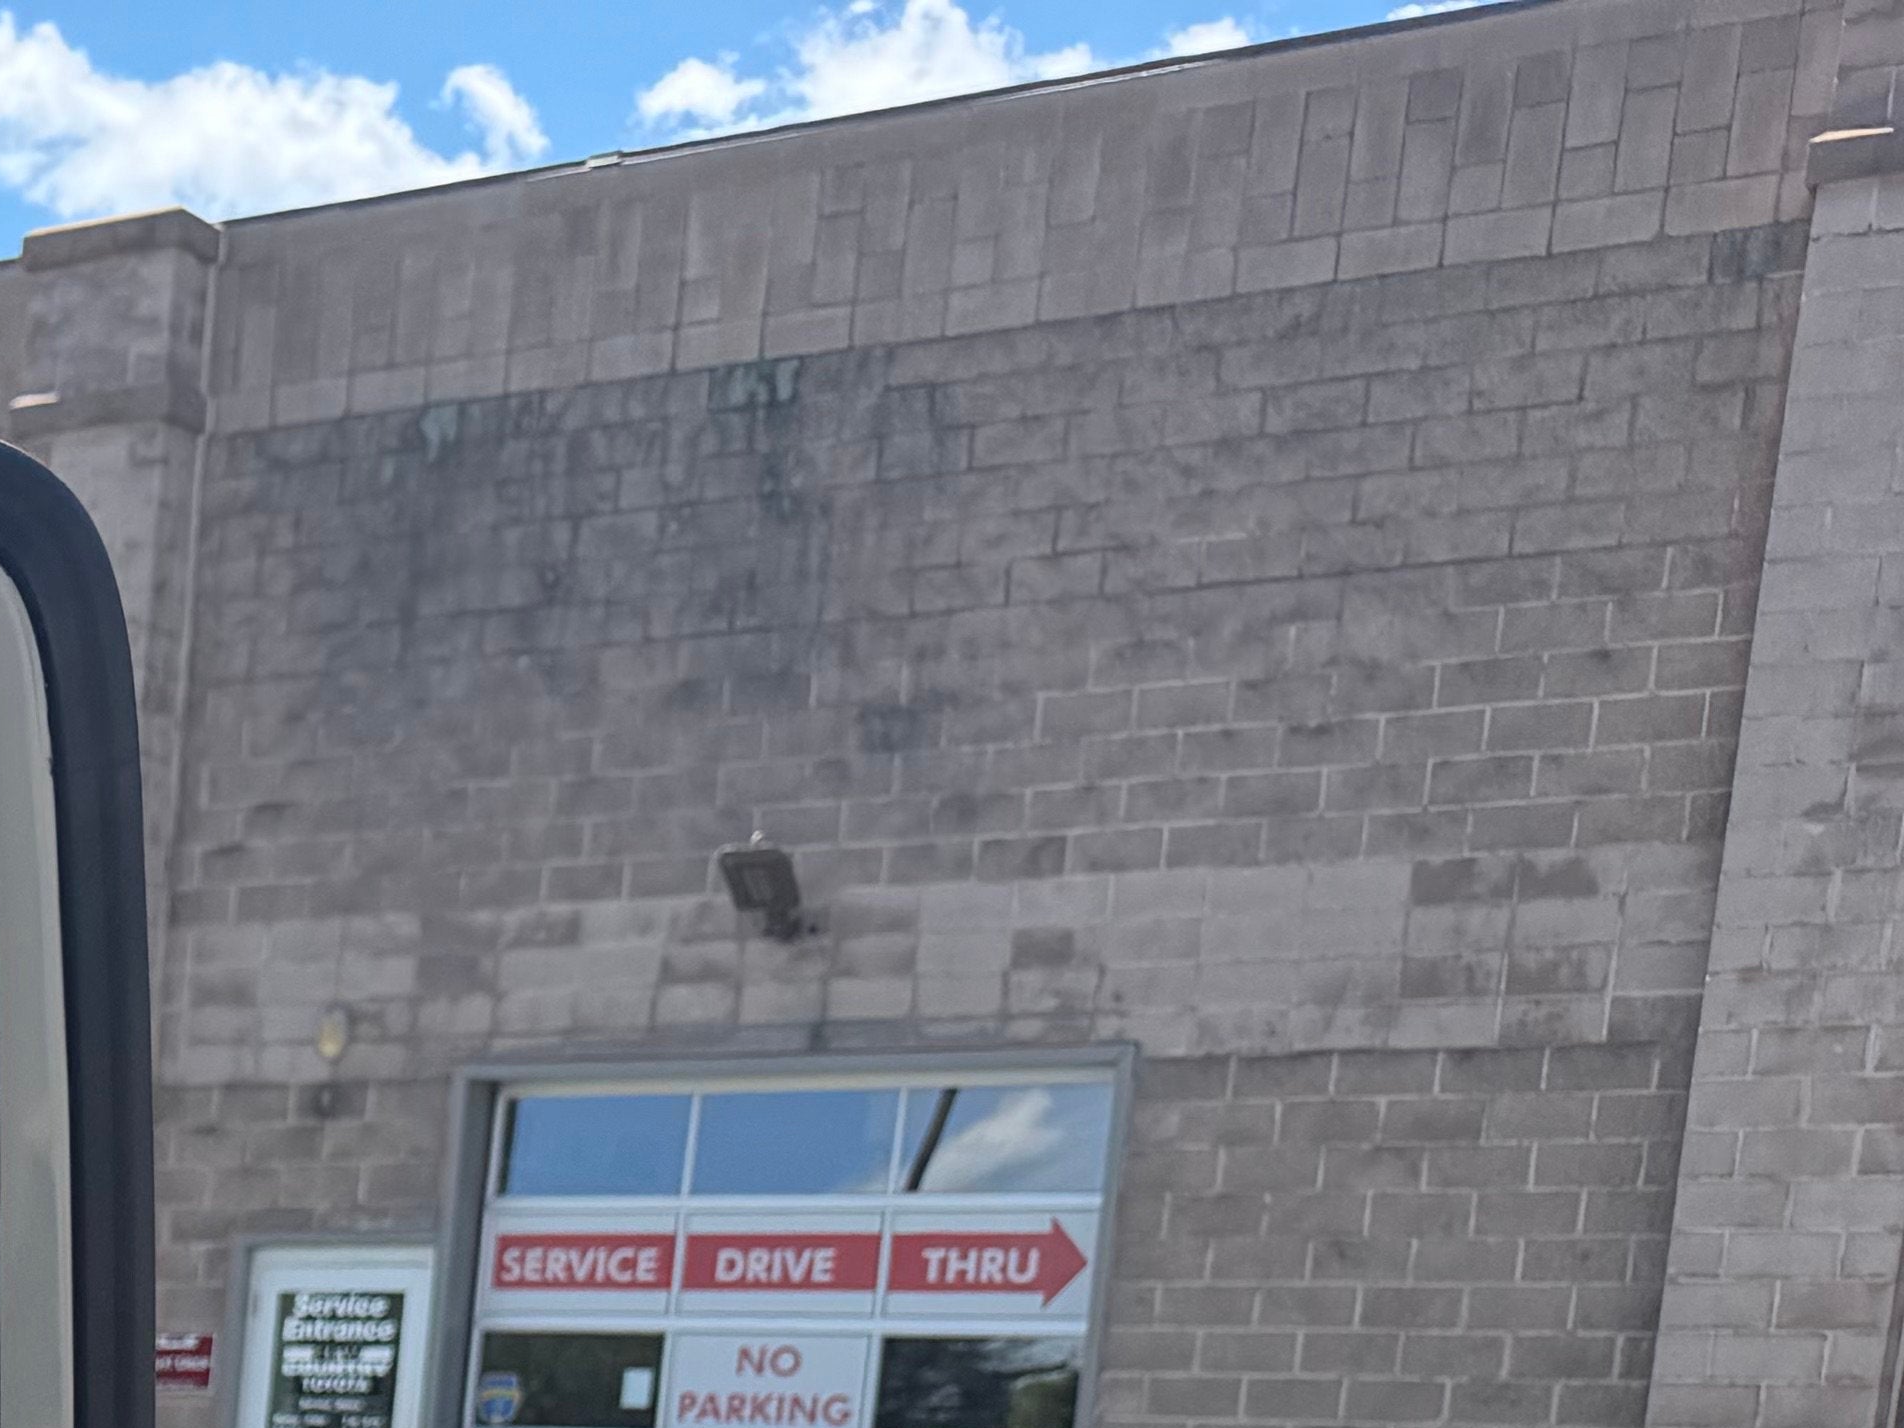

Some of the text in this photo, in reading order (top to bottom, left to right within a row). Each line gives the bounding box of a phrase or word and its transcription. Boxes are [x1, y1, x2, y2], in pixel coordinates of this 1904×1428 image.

[500, 1246, 1041, 1284] SERVICE DRIVE THRU
[293, 1294, 390, 1318] Service
[735, 1344, 803, 1379] NO
[678, 1391, 854, 1427] PARKING
